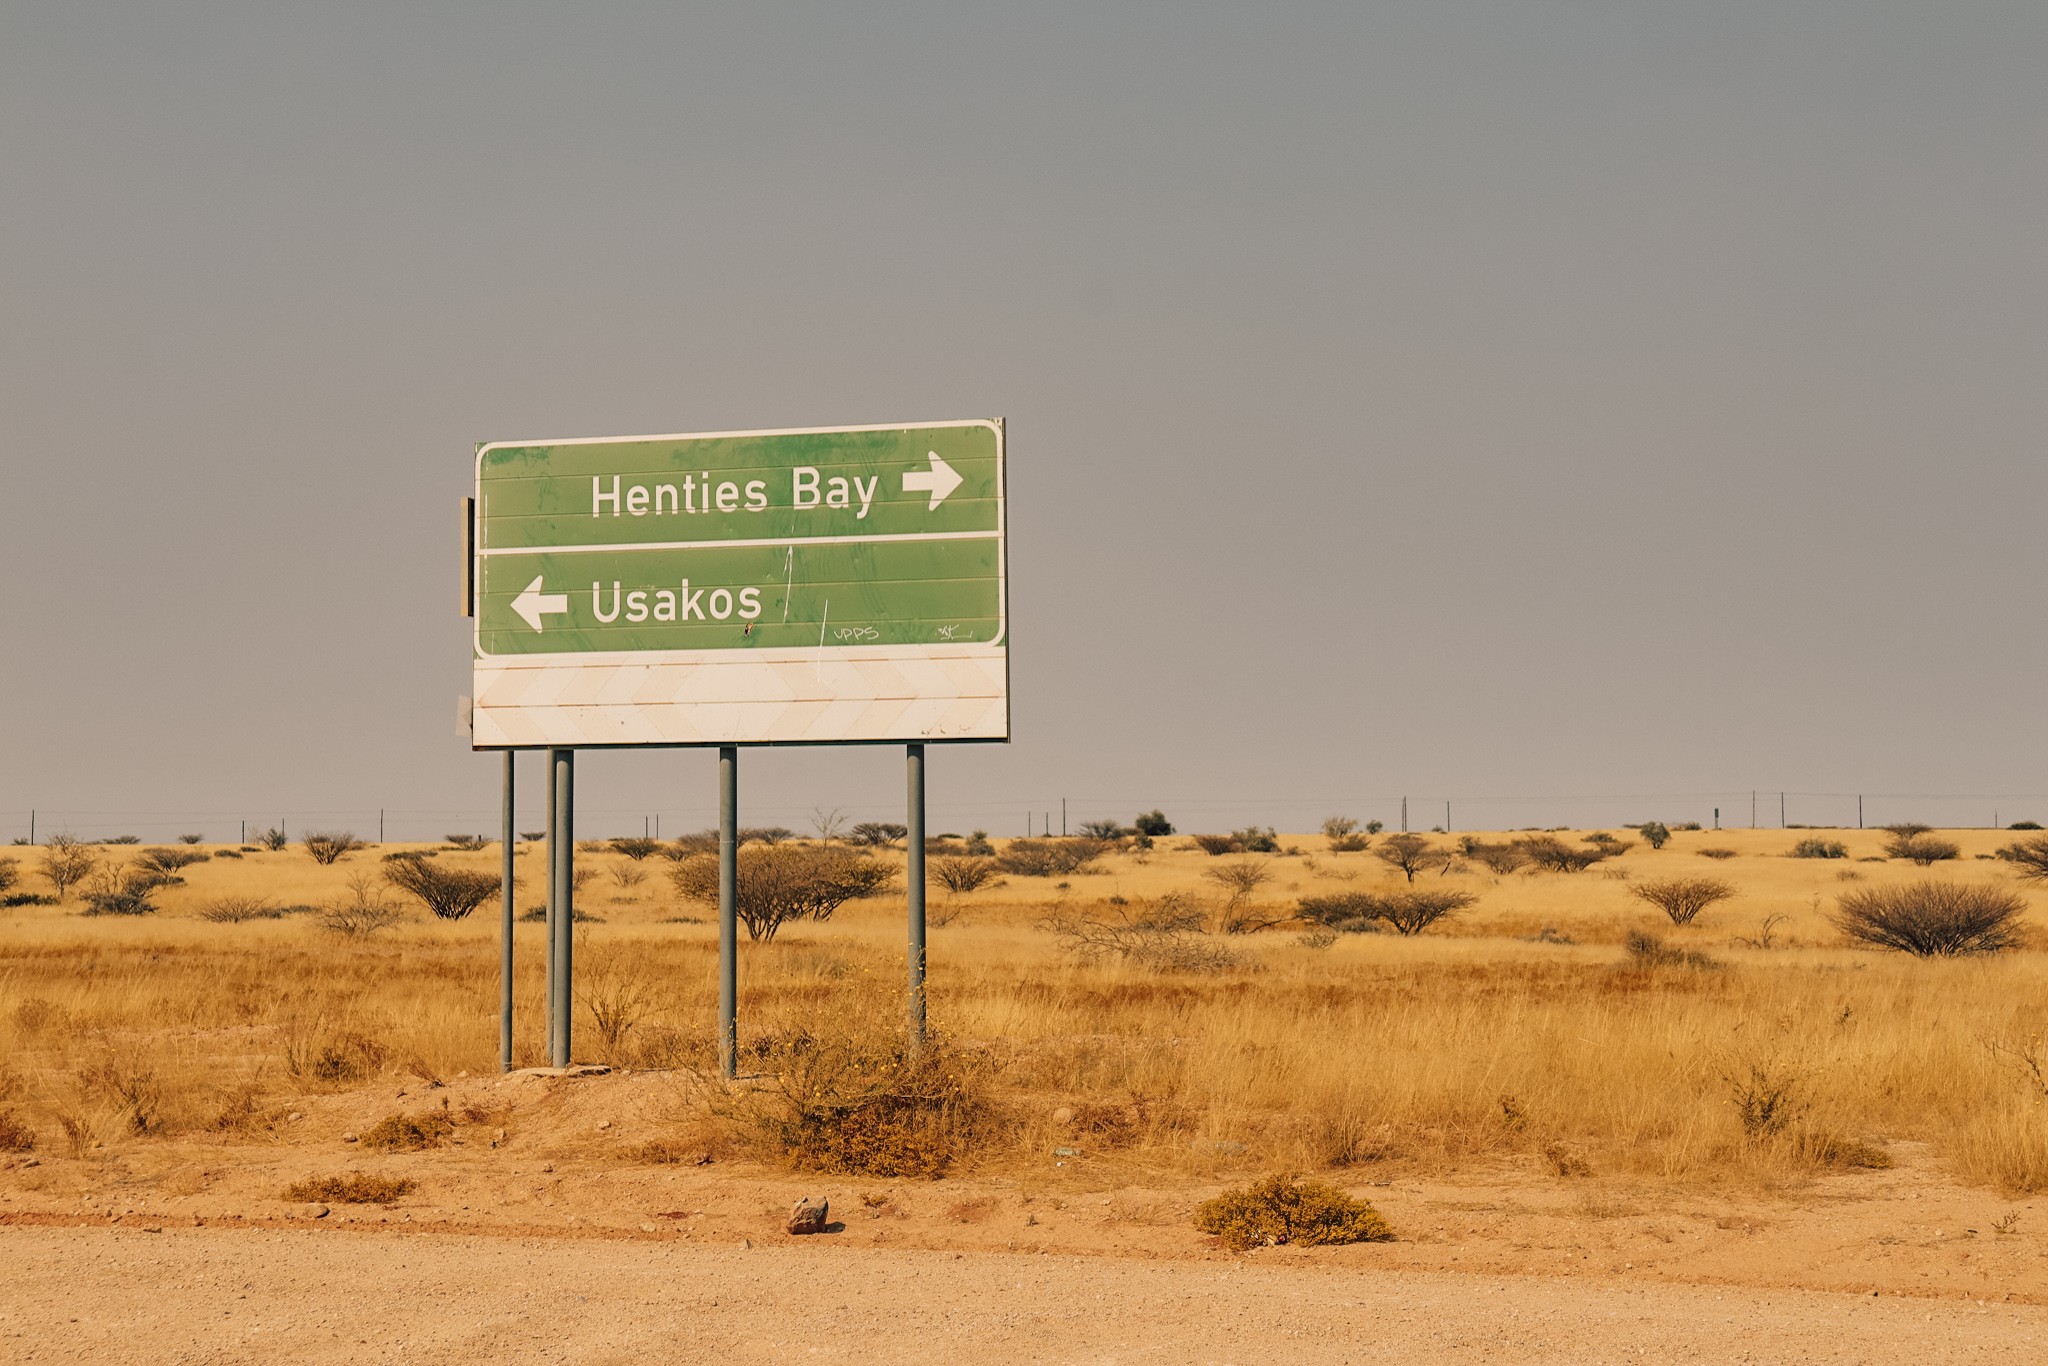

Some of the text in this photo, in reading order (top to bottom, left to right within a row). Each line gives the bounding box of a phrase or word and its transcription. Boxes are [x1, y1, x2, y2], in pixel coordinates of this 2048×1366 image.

[592, 466, 879, 520] Henties Bay
[592, 578, 762, 624] Usakos
